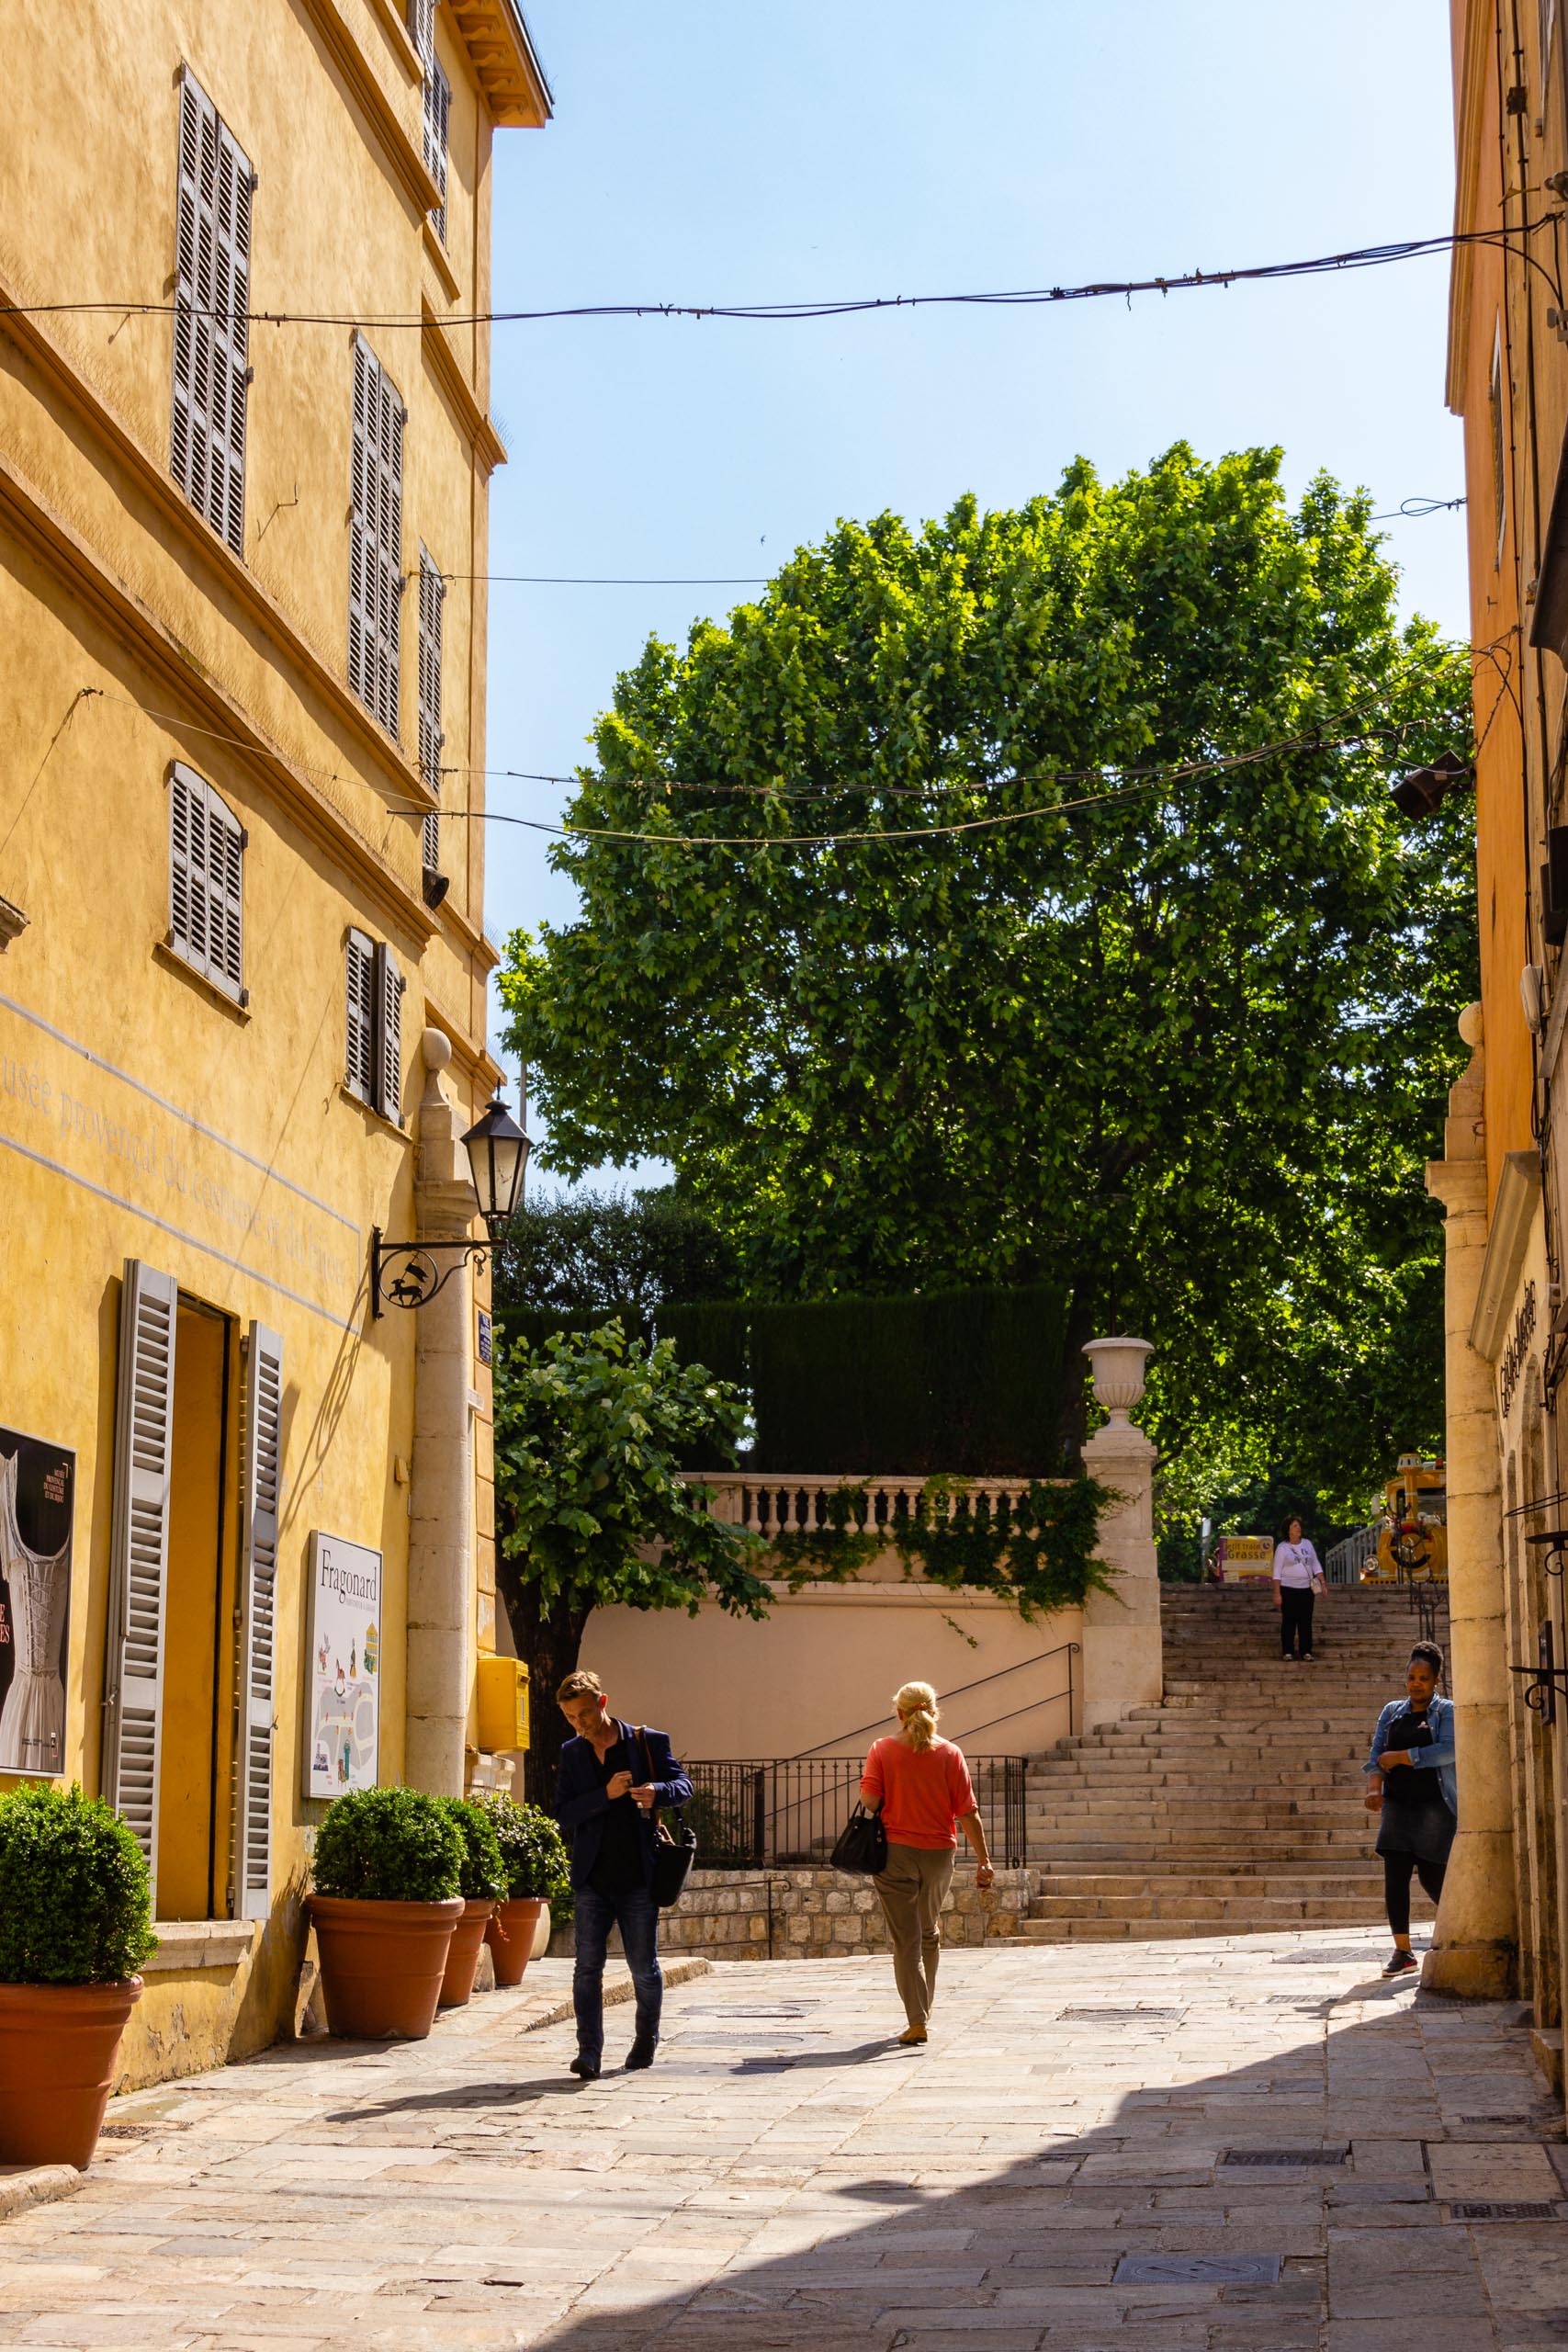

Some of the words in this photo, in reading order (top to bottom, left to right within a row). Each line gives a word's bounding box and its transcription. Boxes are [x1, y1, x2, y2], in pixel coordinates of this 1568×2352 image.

[61, 1091, 156, 1178] provençal
[321, 1548, 377, 1604] Fragonard
[1228, 1549, 1266, 1559] Grasse
